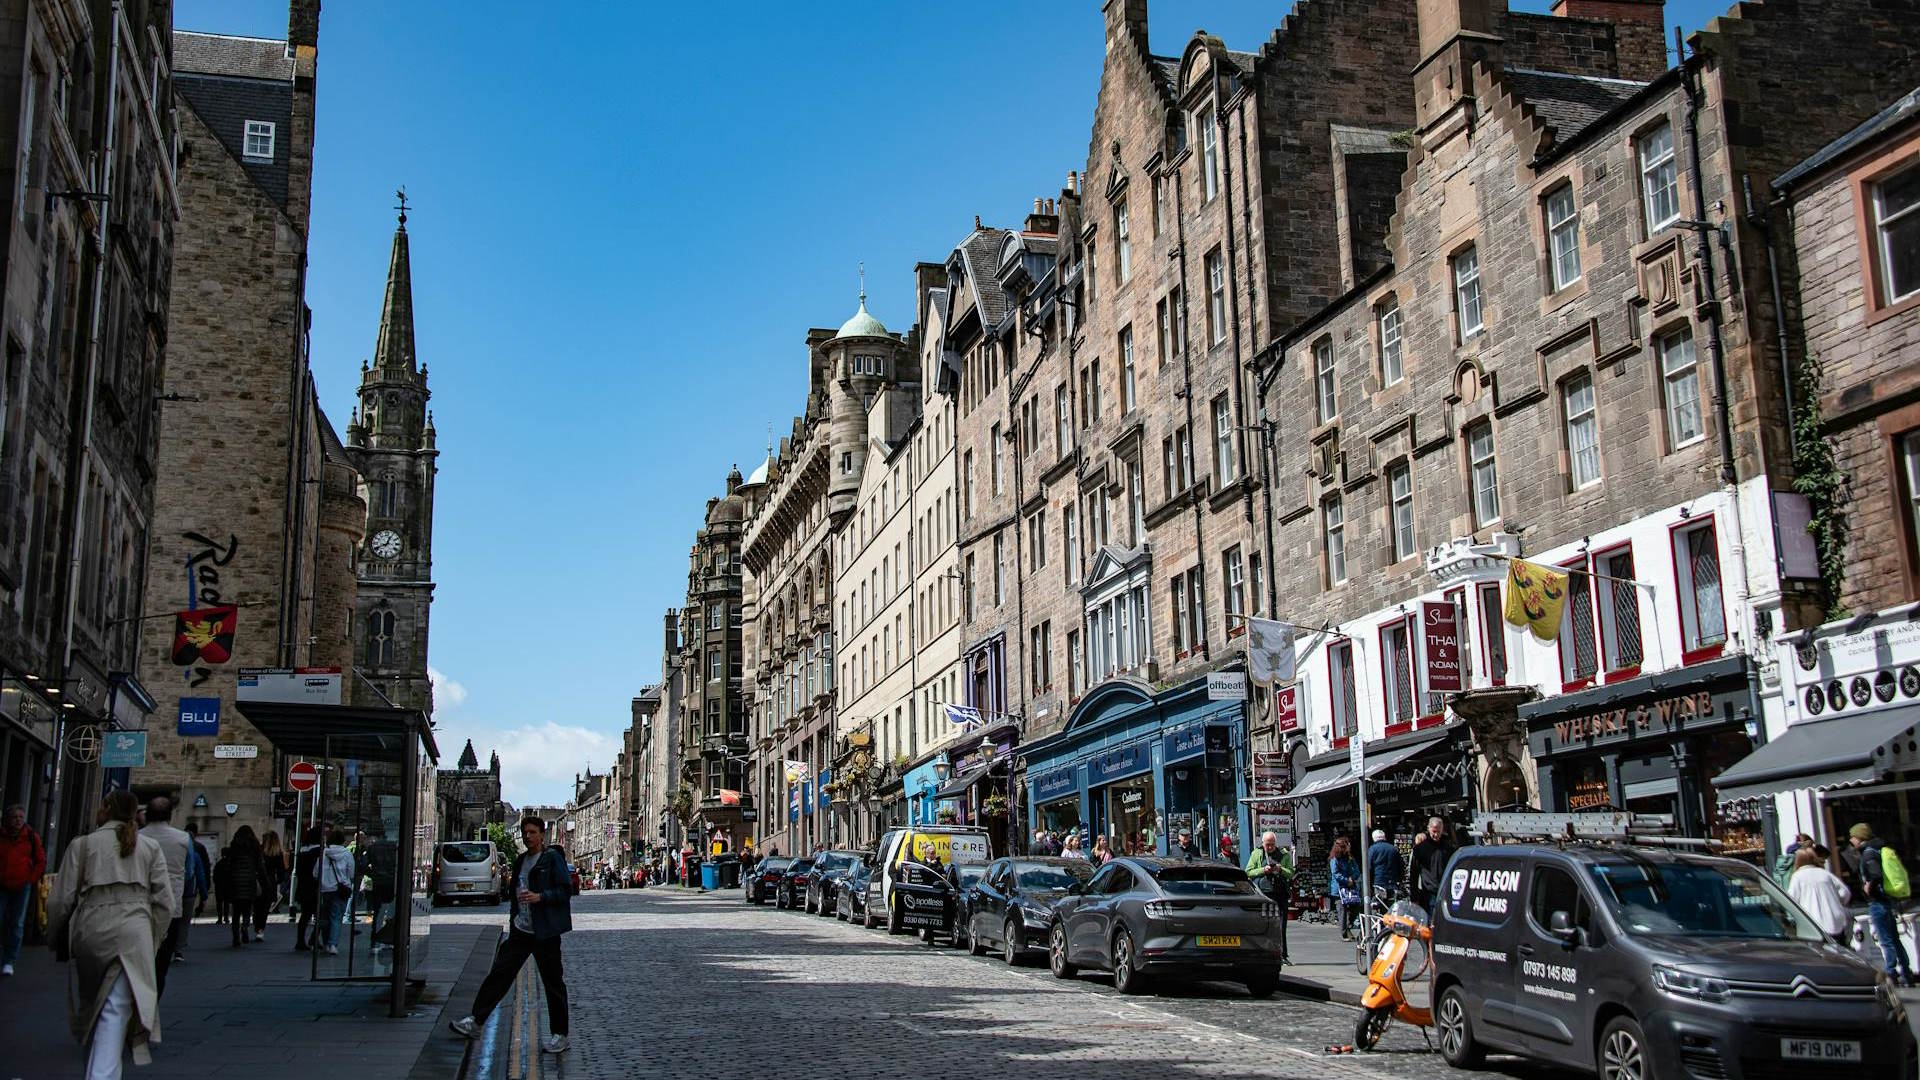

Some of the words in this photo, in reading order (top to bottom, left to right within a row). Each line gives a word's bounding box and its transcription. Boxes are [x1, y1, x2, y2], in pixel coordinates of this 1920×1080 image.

[1427, 635, 1456, 646] THAI
[1439, 648, 1447, 658] &
[1429, 661, 1458, 669] INDIAN
[181, 712, 216, 723] BLU
[1554, 708, 1628, 744] WHISKY
[1654, 690, 1713, 726] WINE
[1469, 869, 1520, 892] DALSON
[1473, 896, 1508, 914] ALARMS
[1523, 960, 1545, 978] 07973
[1546, 964, 1560, 981] 145
[1561, 967, 1576, 983] 898
[1789, 1040, 1822, 1056] MF19
